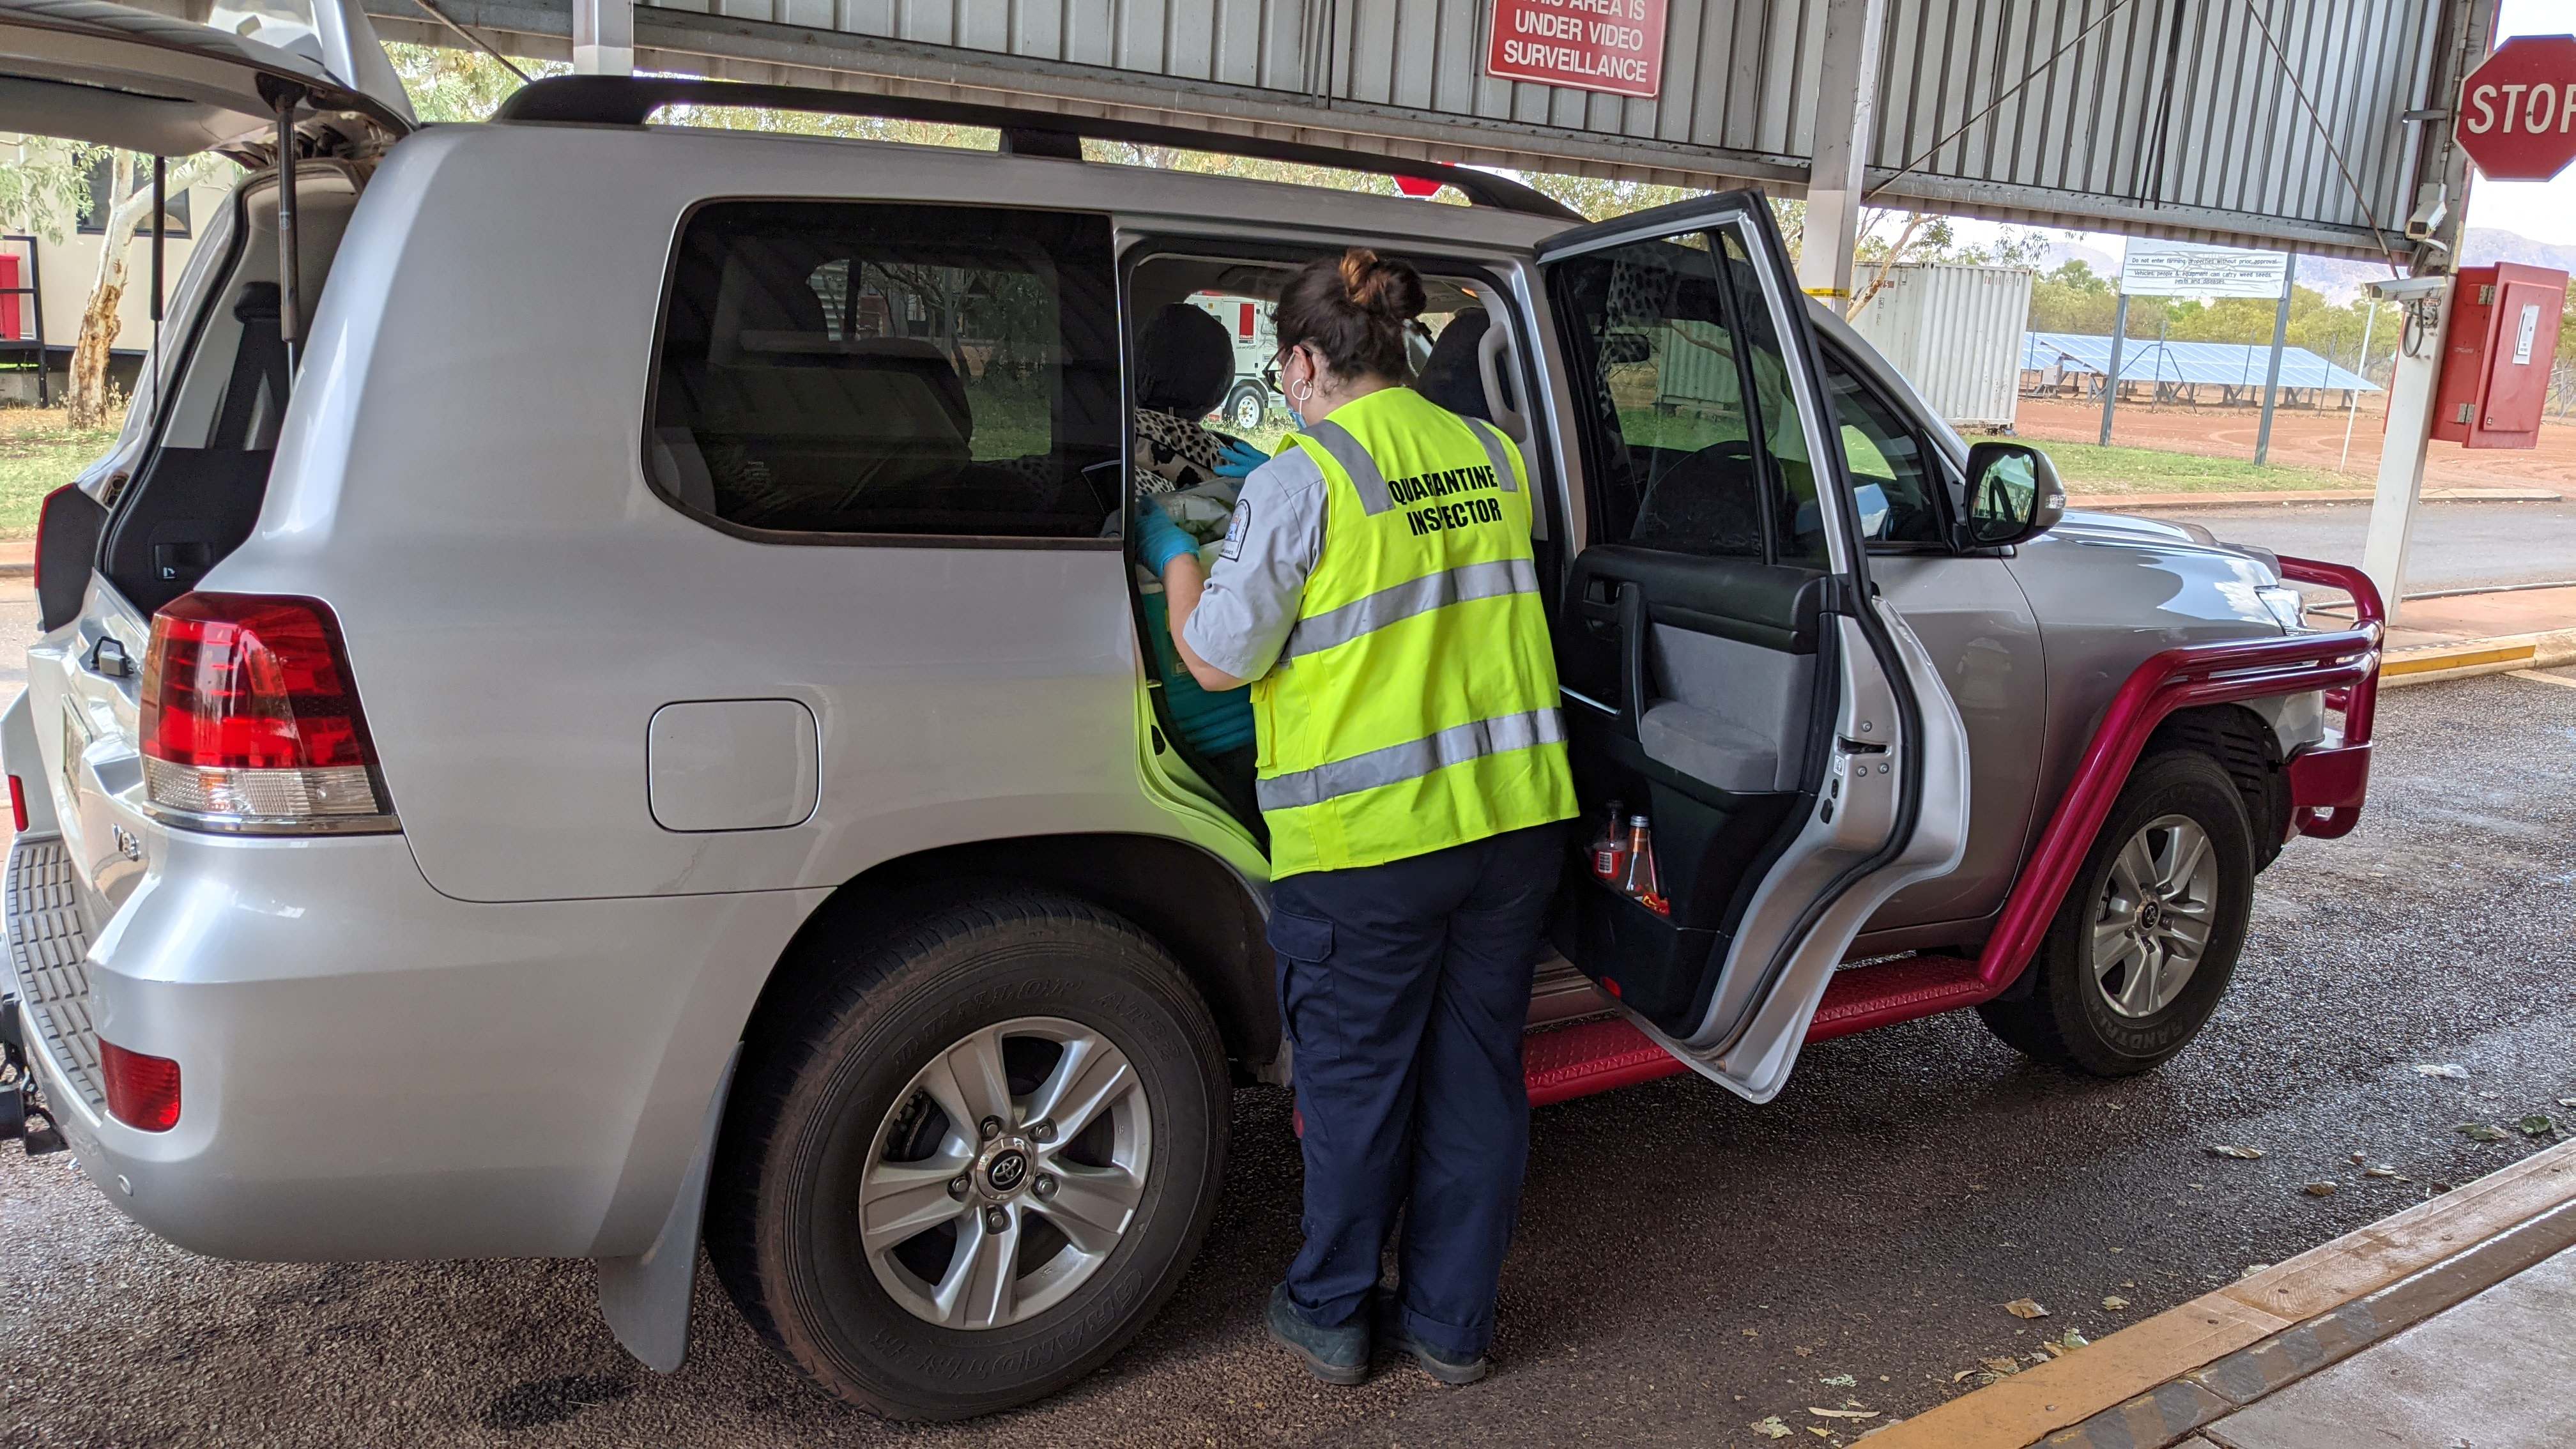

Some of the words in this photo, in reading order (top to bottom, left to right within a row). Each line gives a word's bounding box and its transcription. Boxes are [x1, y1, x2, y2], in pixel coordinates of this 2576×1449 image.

[1515, 9, 1583, 42] UNDER
[1589, 21, 1643, 51] VIDEO
[1629, 0, 1645, 21] IS
[1504, 40, 1648, 82] SURVEILLANCE
[1388, 465, 1498, 505] QUARANTINE
